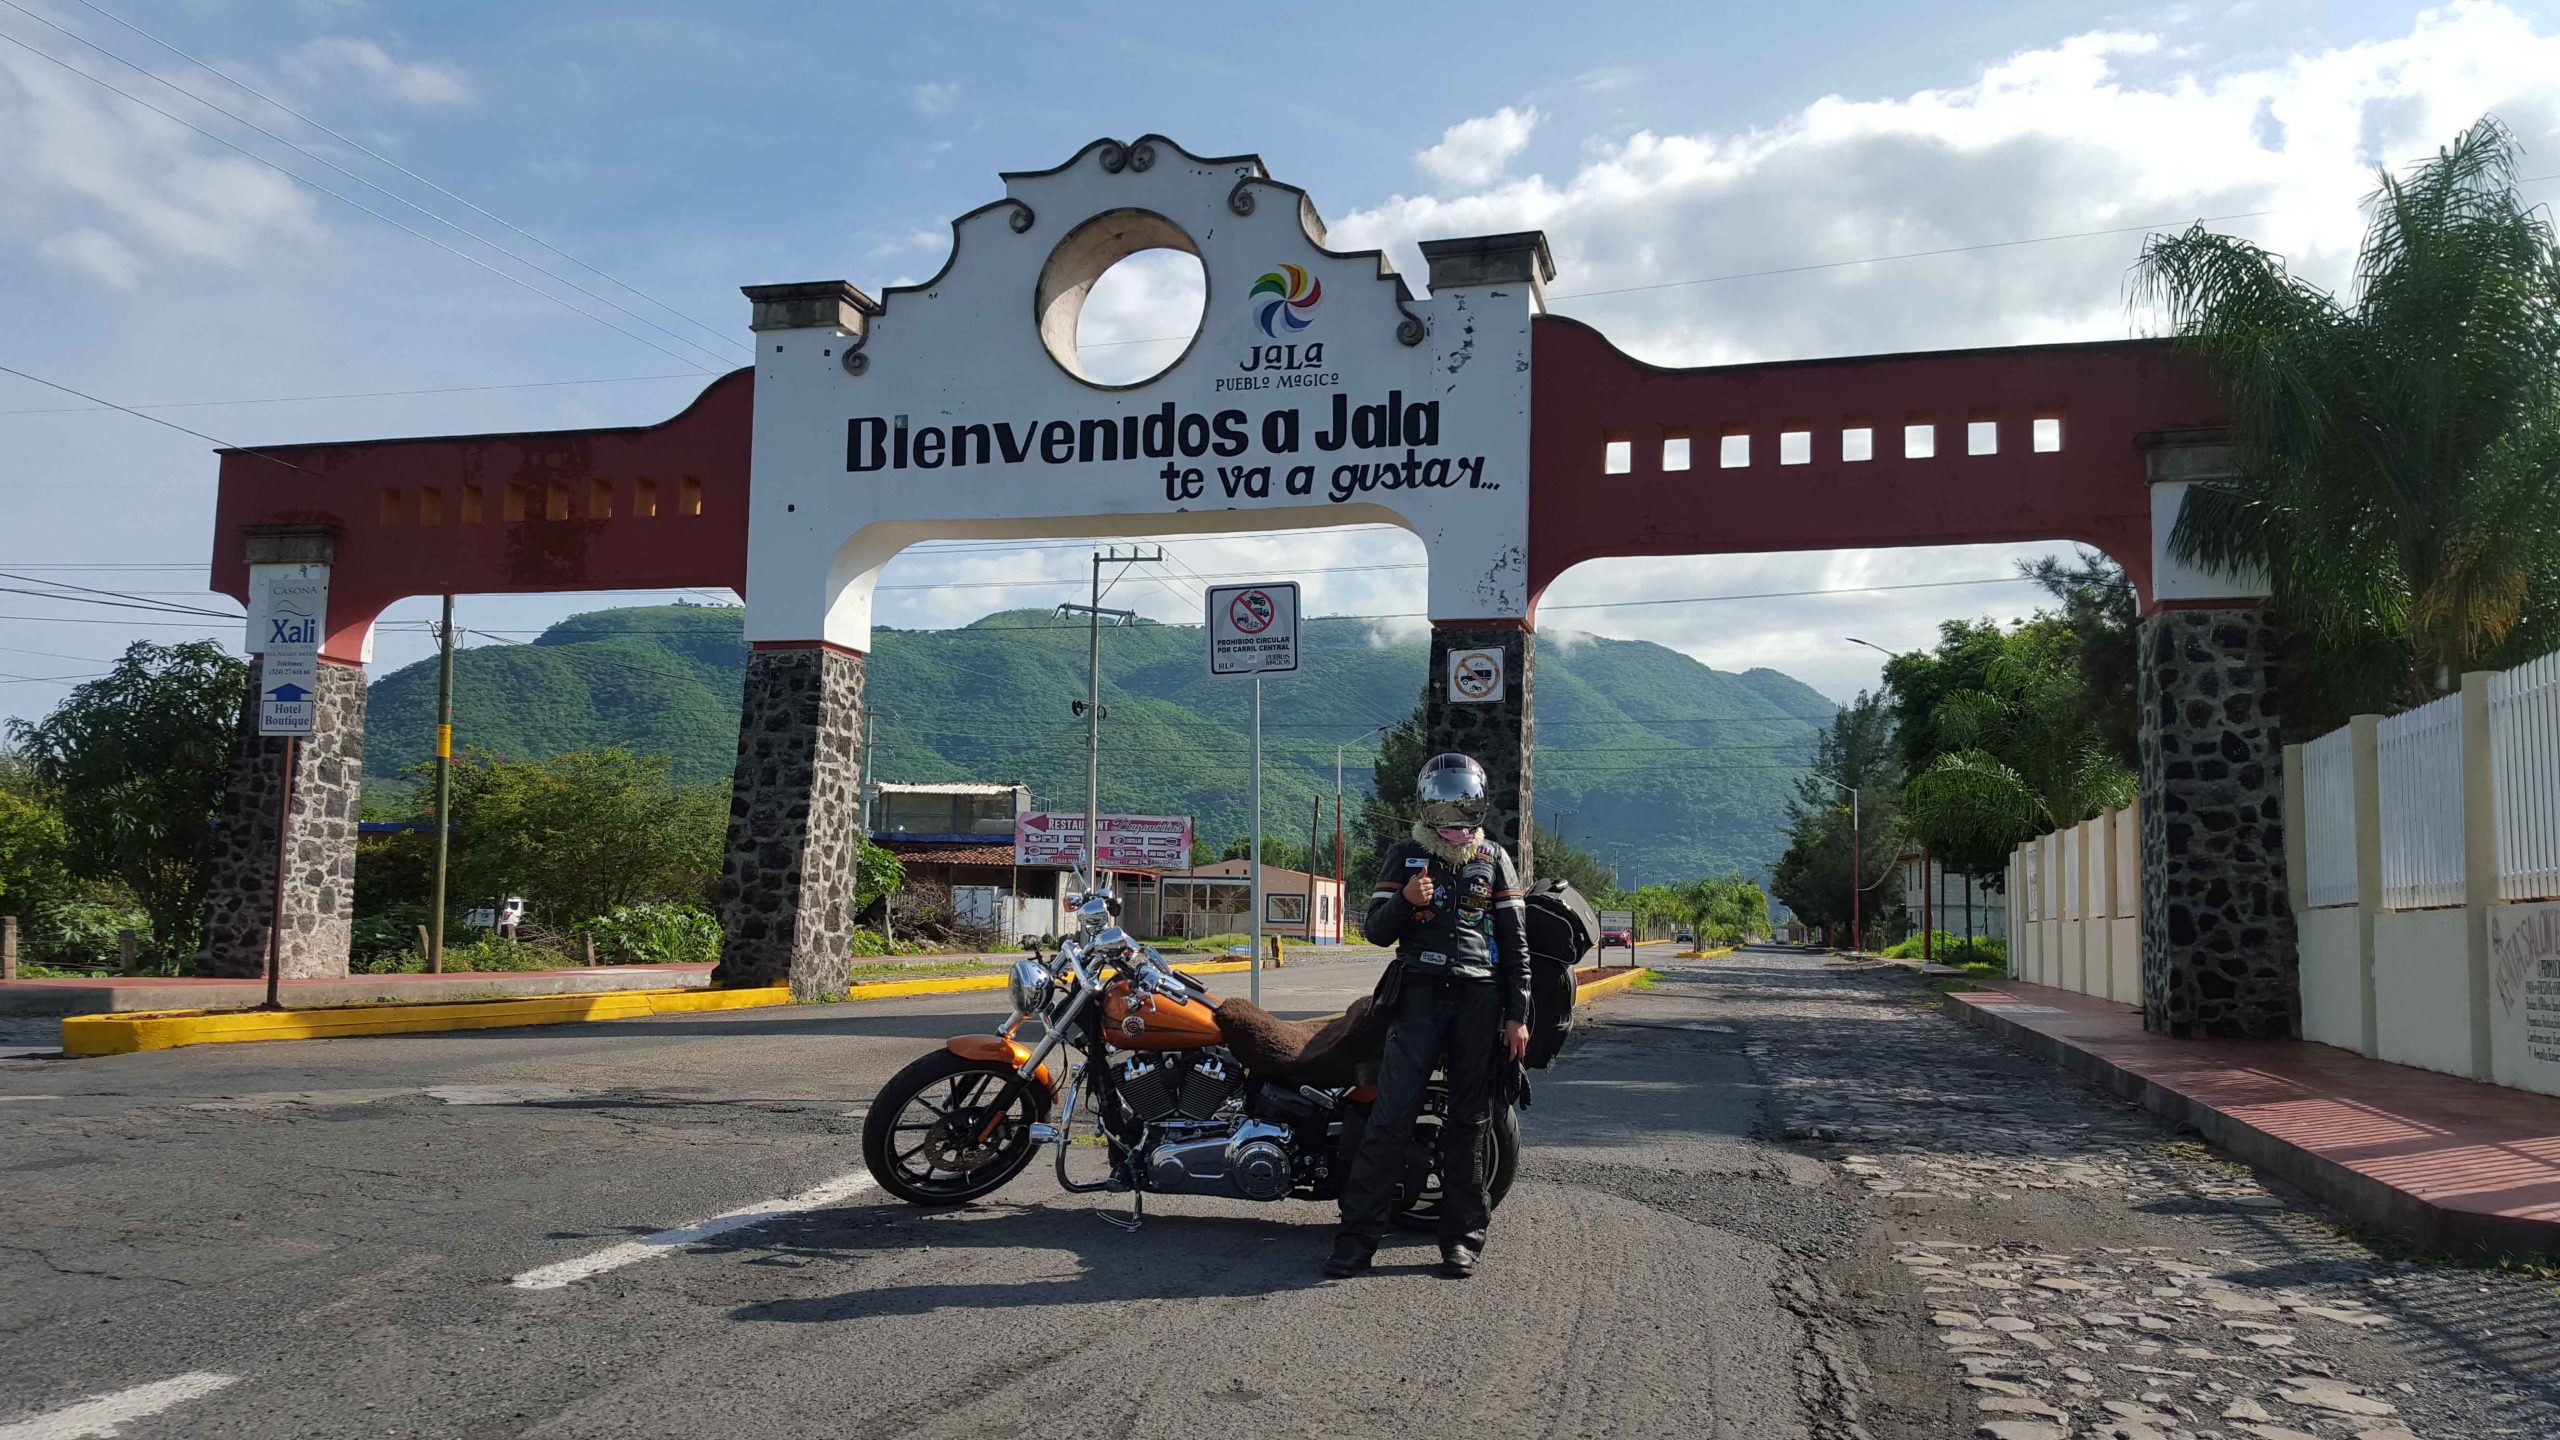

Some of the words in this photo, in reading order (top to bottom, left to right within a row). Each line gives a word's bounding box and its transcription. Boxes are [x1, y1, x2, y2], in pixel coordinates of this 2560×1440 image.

[846, 402, 1249, 472] Bienvenidos
[1261, 408, 1299, 454] a
[1314, 390, 1440, 452] Jala
[1160, 461, 1204, 501] te
[1217, 465, 1271, 498] va
[1285, 465, 1315, 496] a
[273, 585, 318, 596] CASONA
[269, 618, 316, 644] Xali
[1217, 638, 1254, 646] PROHIBIDO
[1256, 636, 1290, 644] CIRCULAR
[1232, 645, 1257, 653] CARRIL
[274, 703, 301, 714] Hotel
[265, 715, 309, 728] Boutique
[1048, 819, 1109, 831] RESTAUNT
